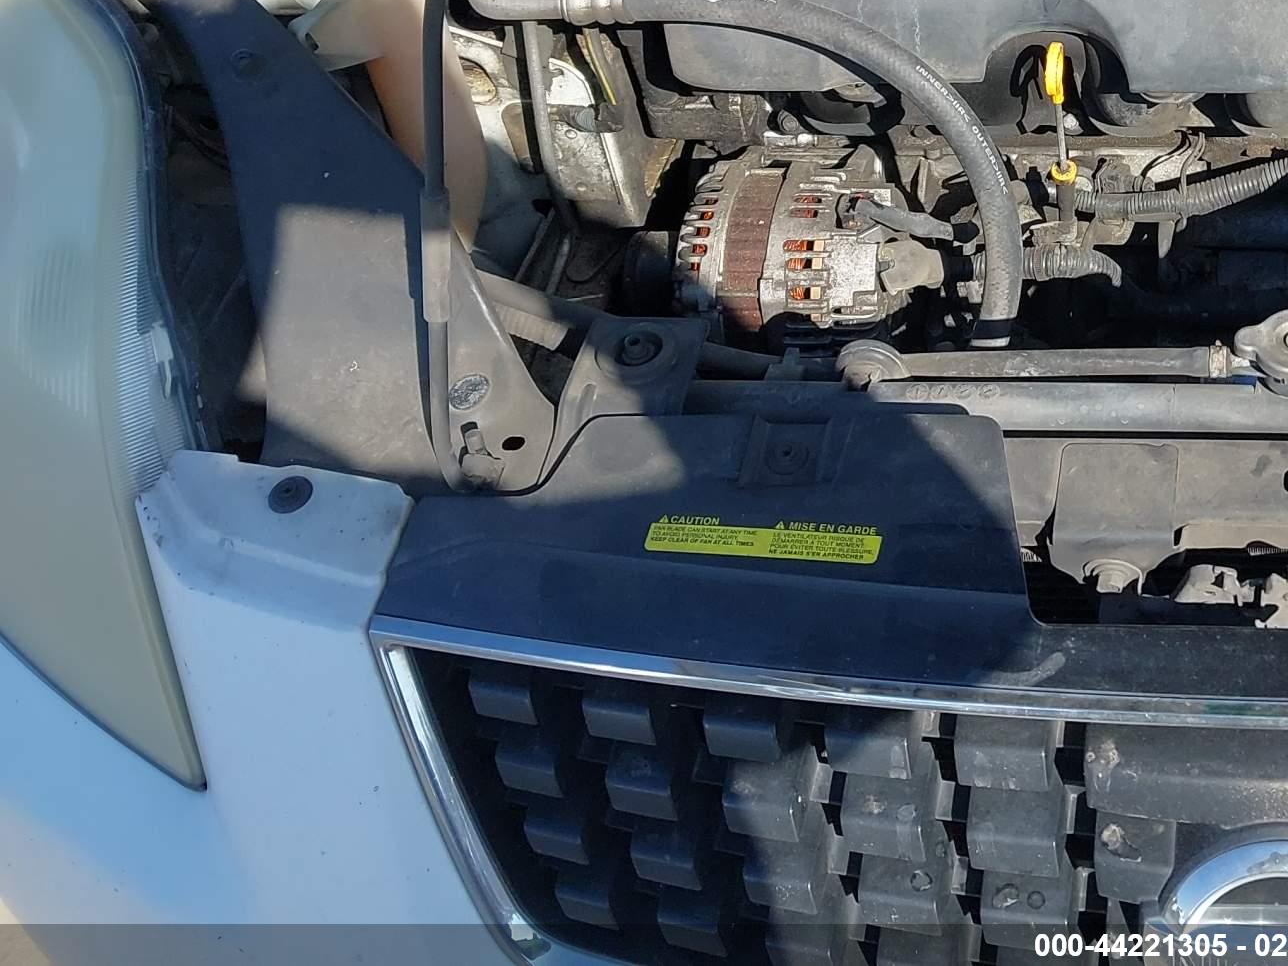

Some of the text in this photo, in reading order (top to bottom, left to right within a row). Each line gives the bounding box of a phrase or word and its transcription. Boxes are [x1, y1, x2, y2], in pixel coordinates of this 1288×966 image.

[670, 515, 720, 525] CAUTION
[788, 522, 878, 536] MISE EN GARDE
